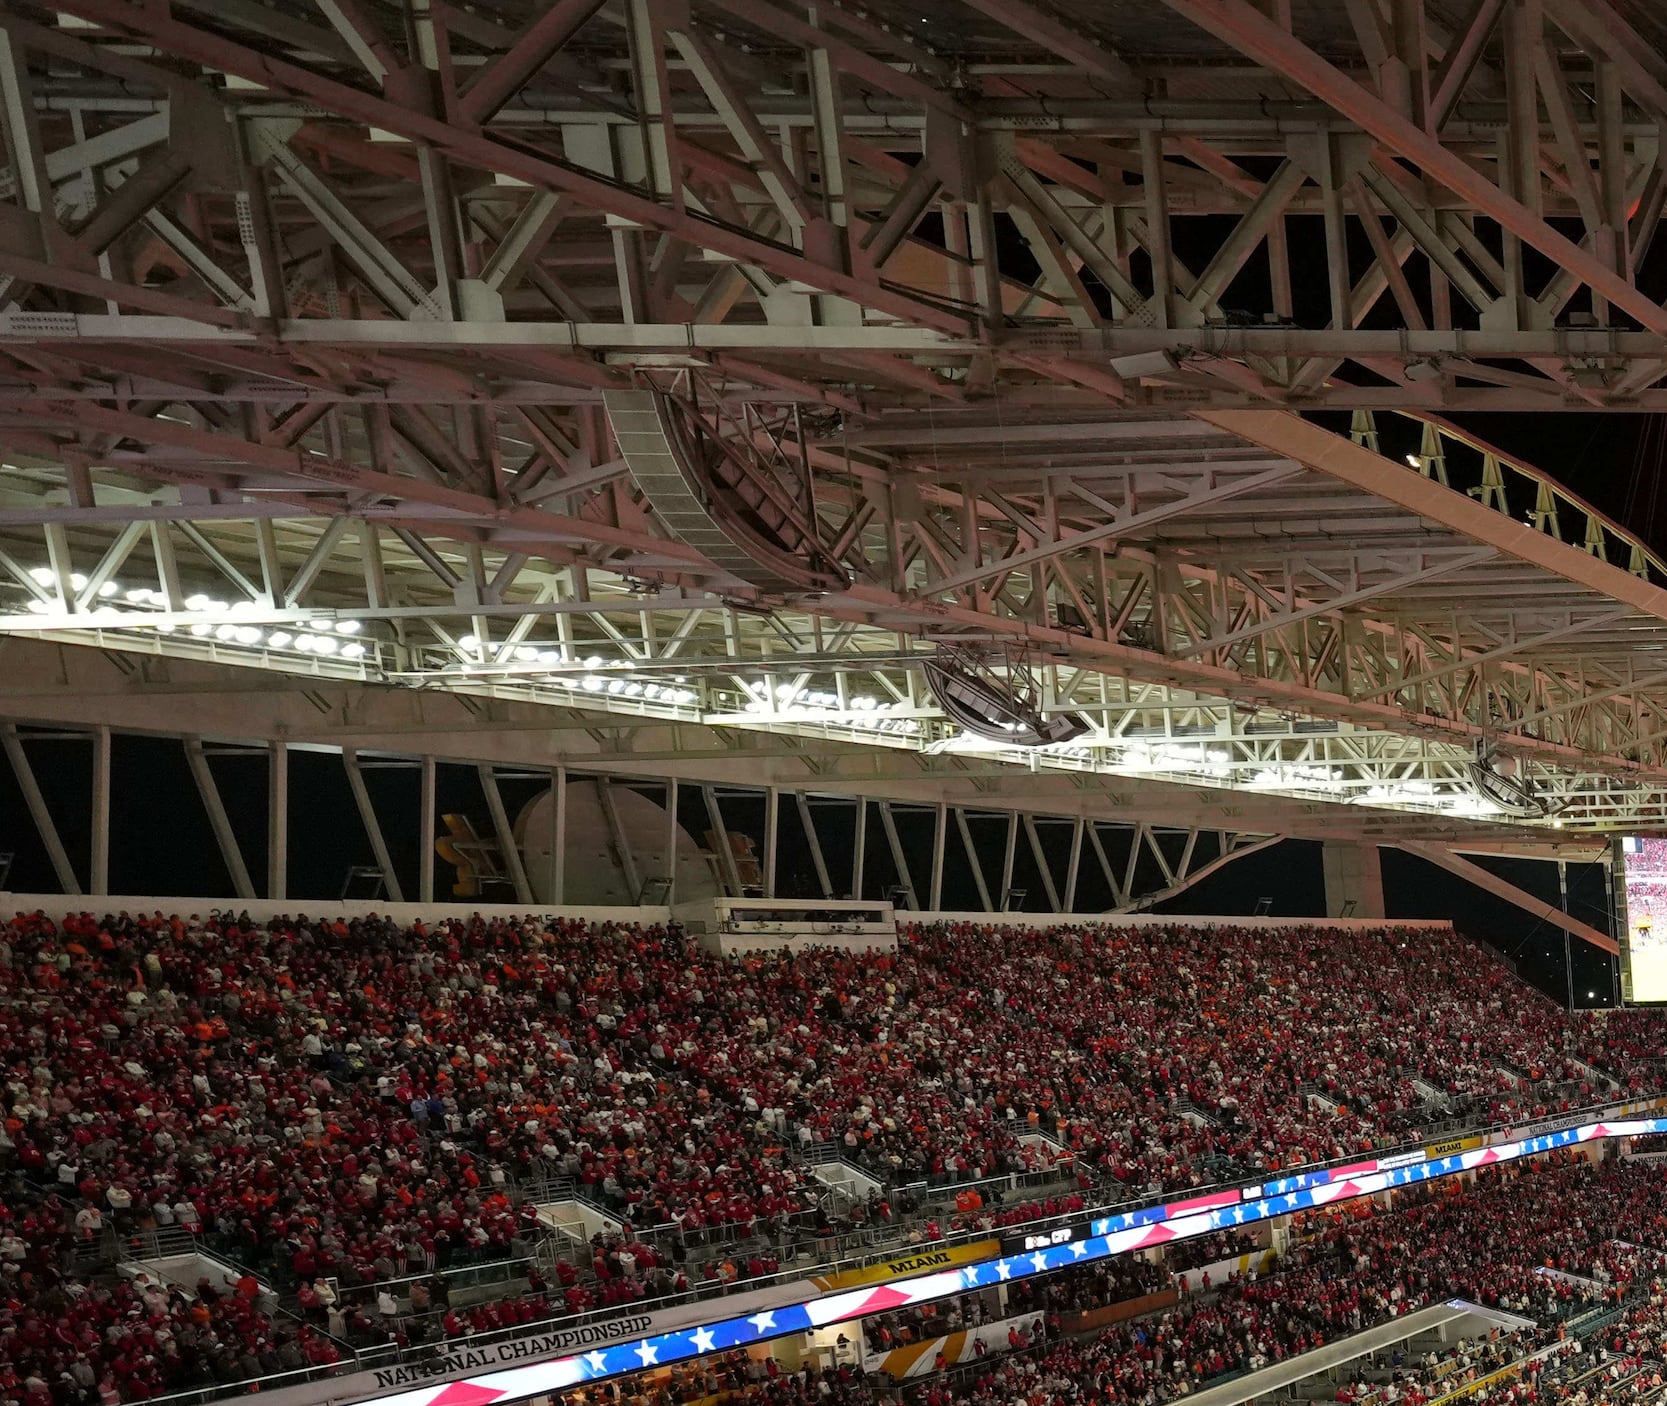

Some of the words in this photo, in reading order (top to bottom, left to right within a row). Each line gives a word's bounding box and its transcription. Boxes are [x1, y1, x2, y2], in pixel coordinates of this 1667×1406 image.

[1529, 1123, 1552, 1136] NATIONAL
[1435, 1141, 1462, 1156] MIAMI
[888, 1252, 952, 1274] MIAMI
[497, 1315, 653, 1361] CHAMPIONSHIP
